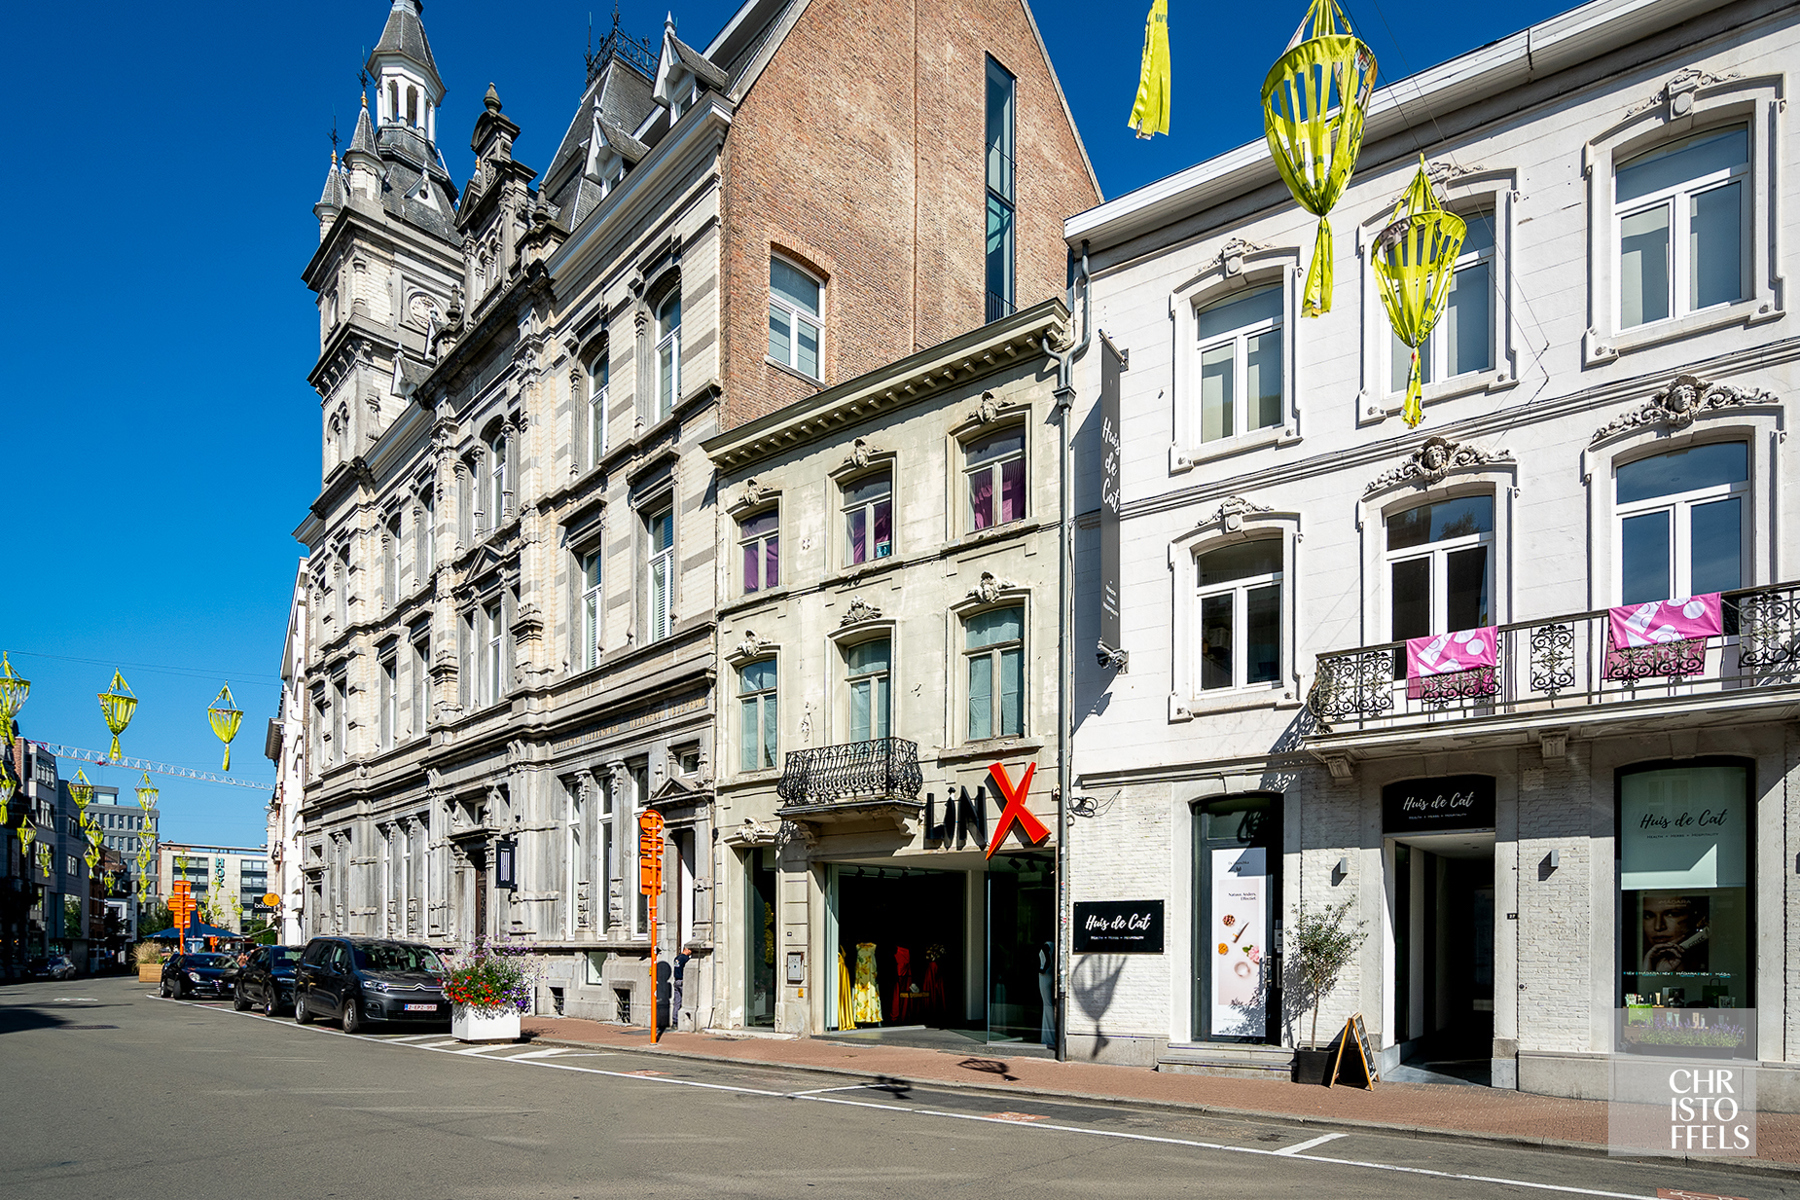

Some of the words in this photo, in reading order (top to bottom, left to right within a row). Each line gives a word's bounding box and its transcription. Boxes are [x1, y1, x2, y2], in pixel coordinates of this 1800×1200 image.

[1102, 416, 1120, 456] Huis
[1105, 452, 1117, 476] de
[1102, 477, 1119, 513] Cat
[1403, 796, 1429, 812] Huis
[1430, 794, 1448, 809] de
[1450, 791, 1474, 808] Cat
[1640, 813, 1671, 829] Huis
[1674, 812, 1694, 828] de
[1698, 808, 1728, 827] Cat
[1085, 914, 1110, 931] Huis
[1111, 915, 1127, 930] de
[1128, 913, 1151, 931] Cat
